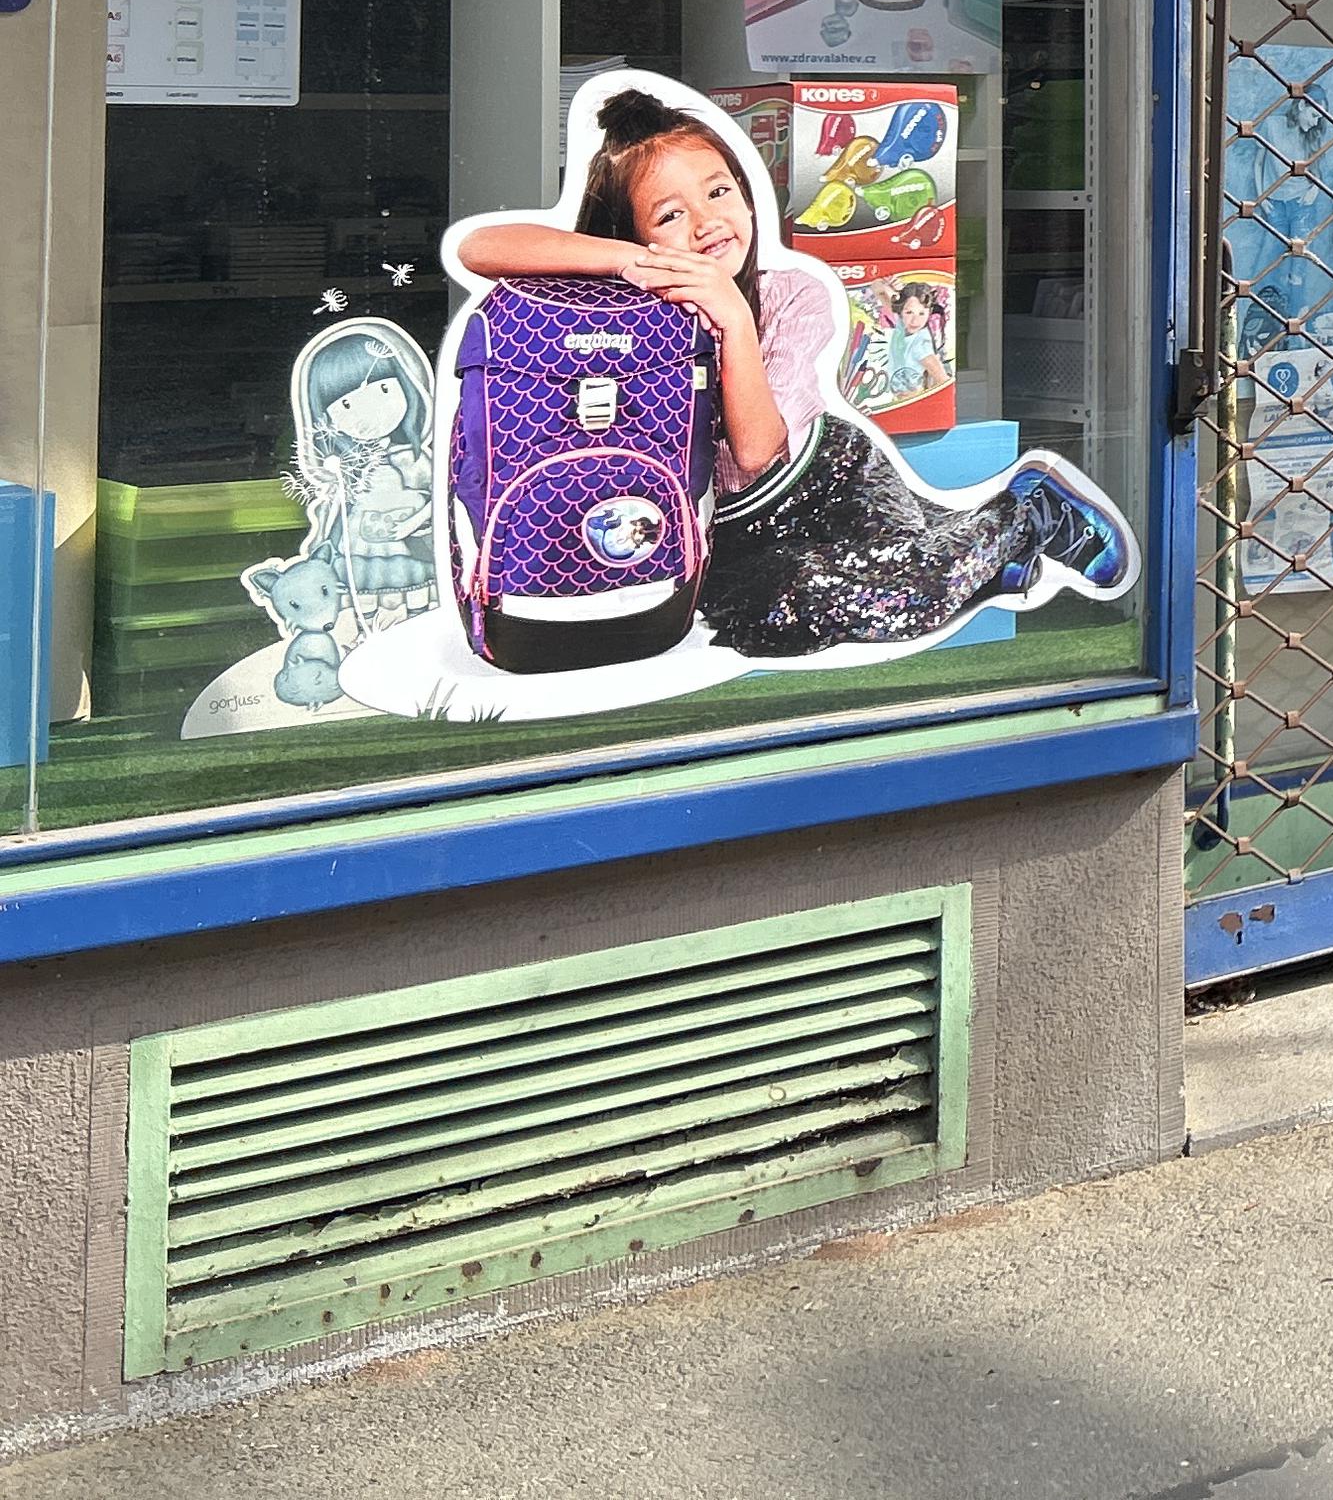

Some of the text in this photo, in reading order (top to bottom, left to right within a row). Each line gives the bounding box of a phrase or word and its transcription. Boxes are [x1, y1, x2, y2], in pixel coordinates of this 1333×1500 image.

[761, 52, 877, 65] www.zdravalahev.cz
[564, 328, 633, 355] ergobag
[208, 694, 261, 715] gorjuss
